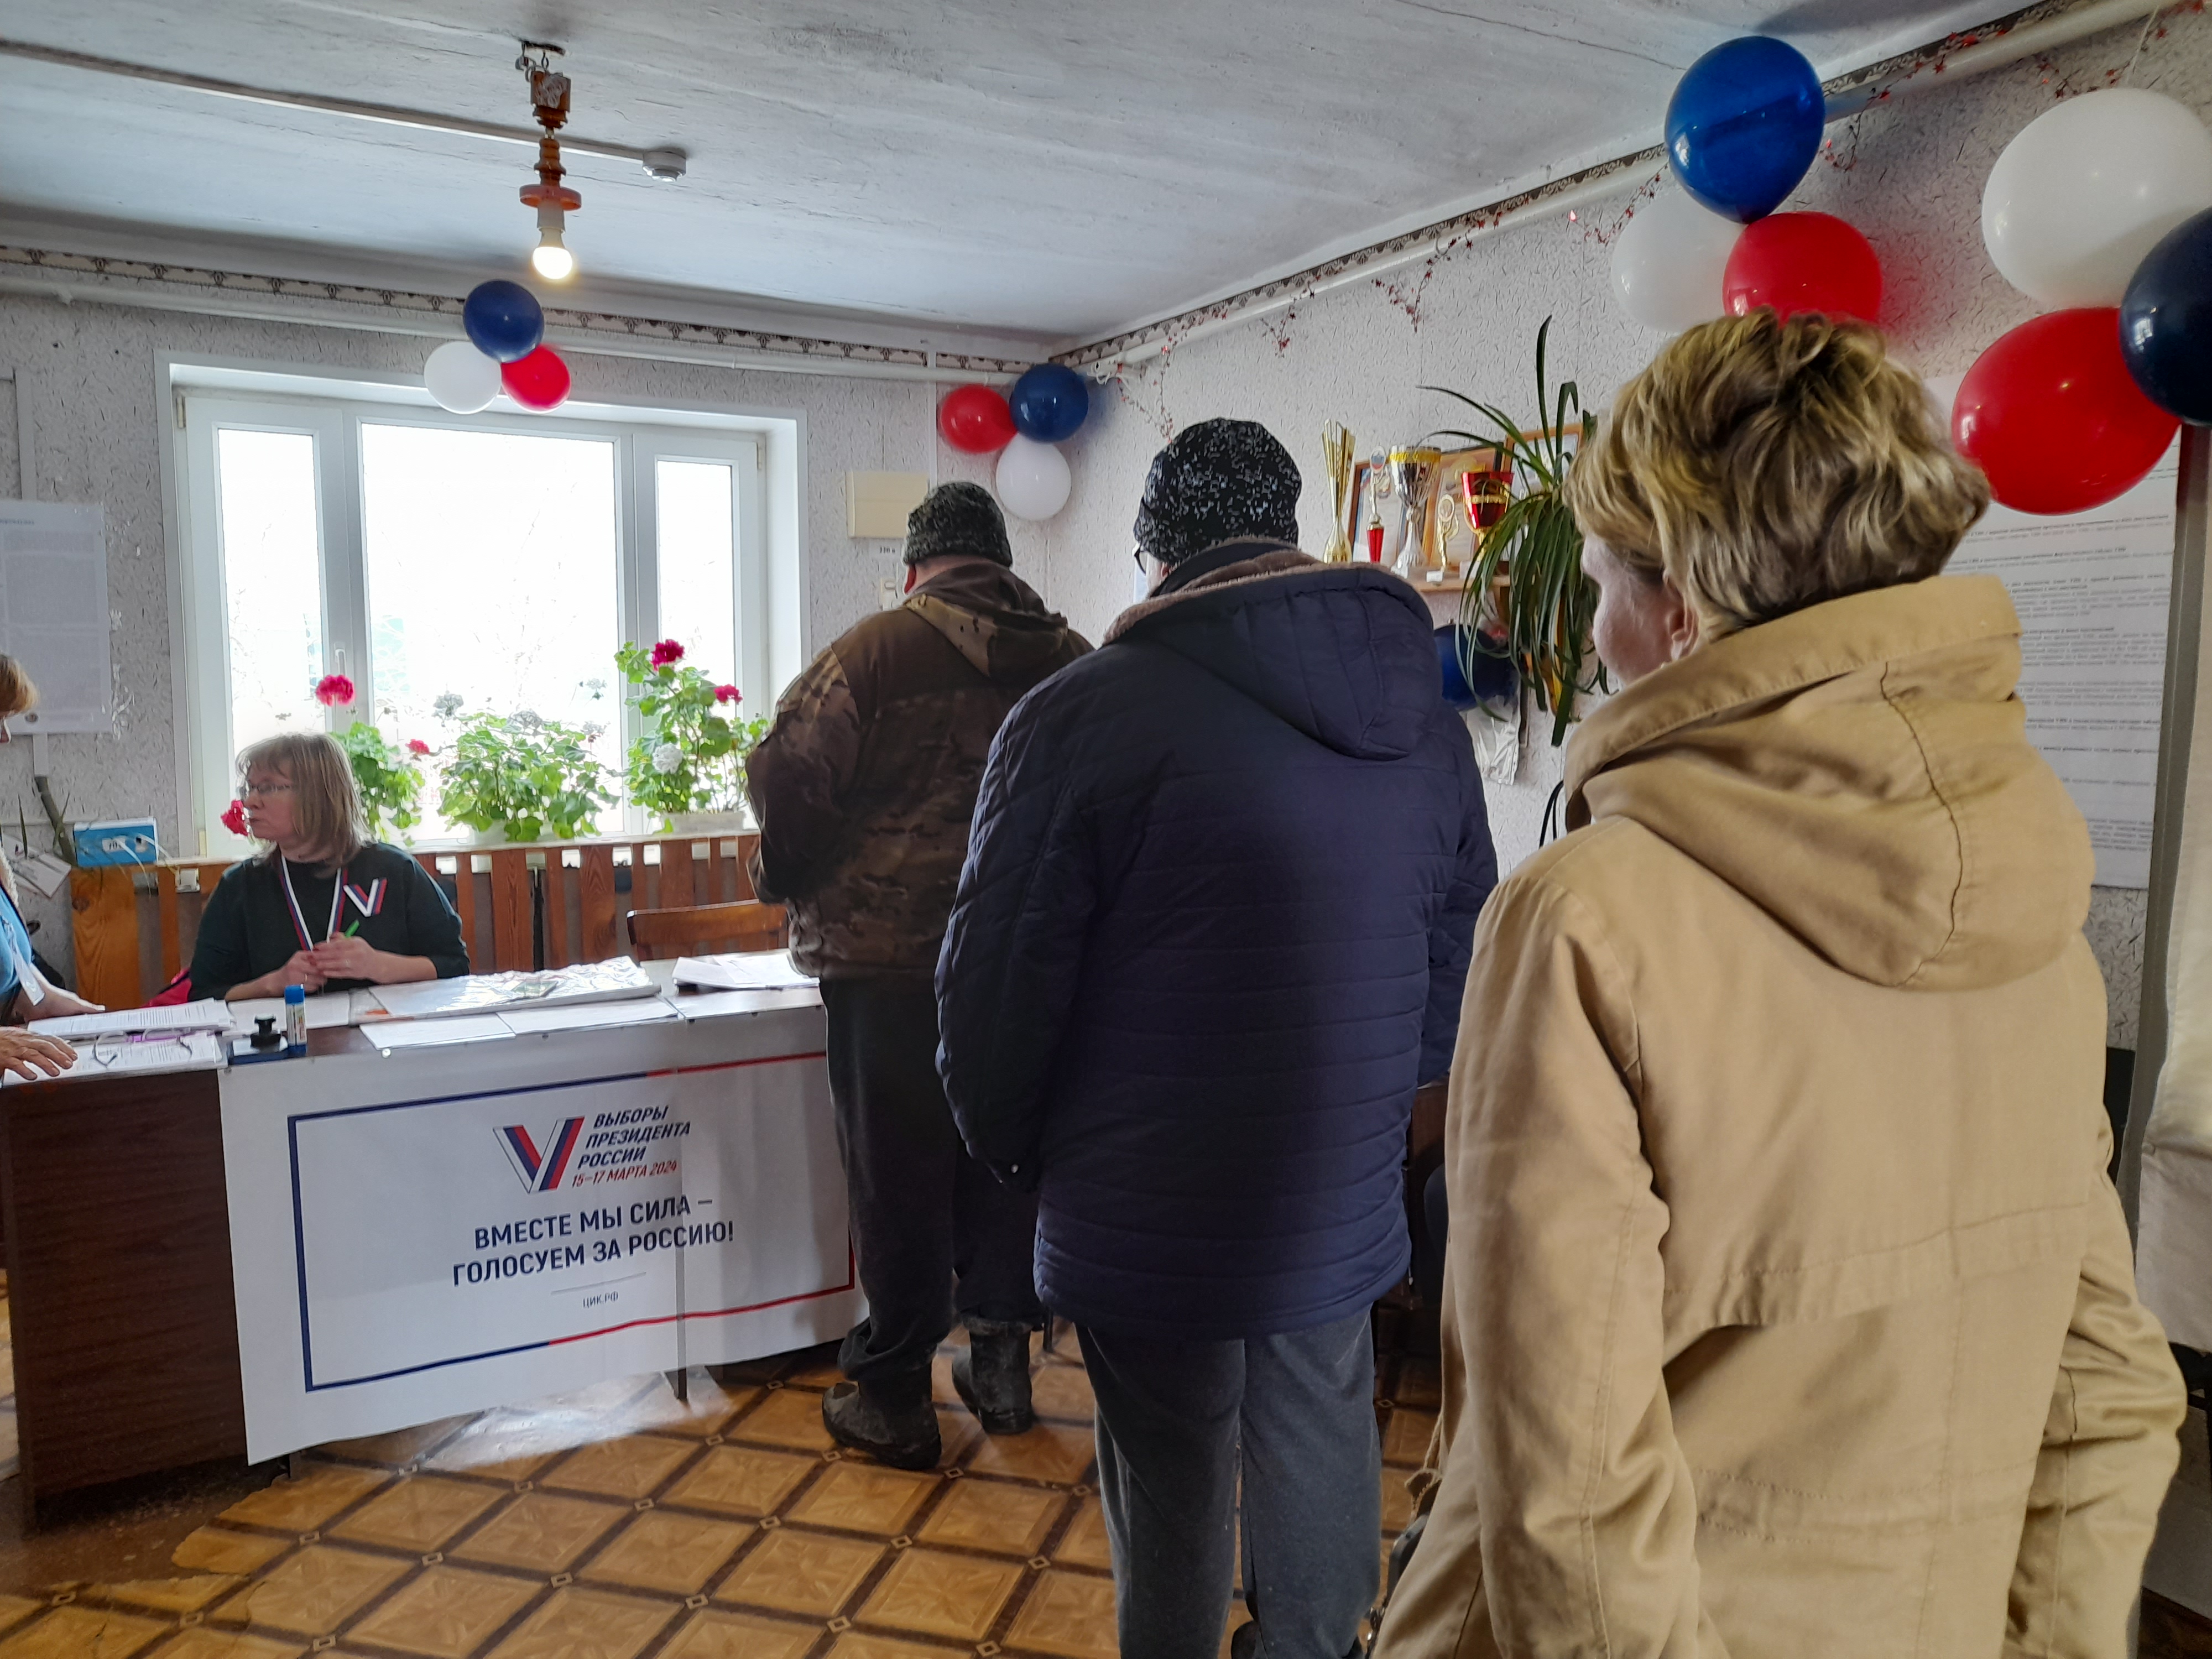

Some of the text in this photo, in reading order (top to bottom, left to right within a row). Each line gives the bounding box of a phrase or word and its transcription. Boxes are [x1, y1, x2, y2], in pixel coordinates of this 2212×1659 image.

[593, 1105, 669, 1129] ВЫБОРЫ
[585, 1121, 691, 1149] ПРЕЗИДЕНТА
[578, 1146, 646, 1170] РОССИИ
[607, 1164, 647, 1182] МАРТА
[649, 1160, 677, 1176] 2024
[474, 1213, 572, 1251] ВМЕСТЕ
[580, 1206, 622, 1233] МЫ
[630, 1194, 691, 1224] СИЛА
[453, 1220, 734, 1287] ГОЛОСУЕМ ЗА РОССИЮ!
[582, 1291, 619, 1309] ЦИК.РФ
